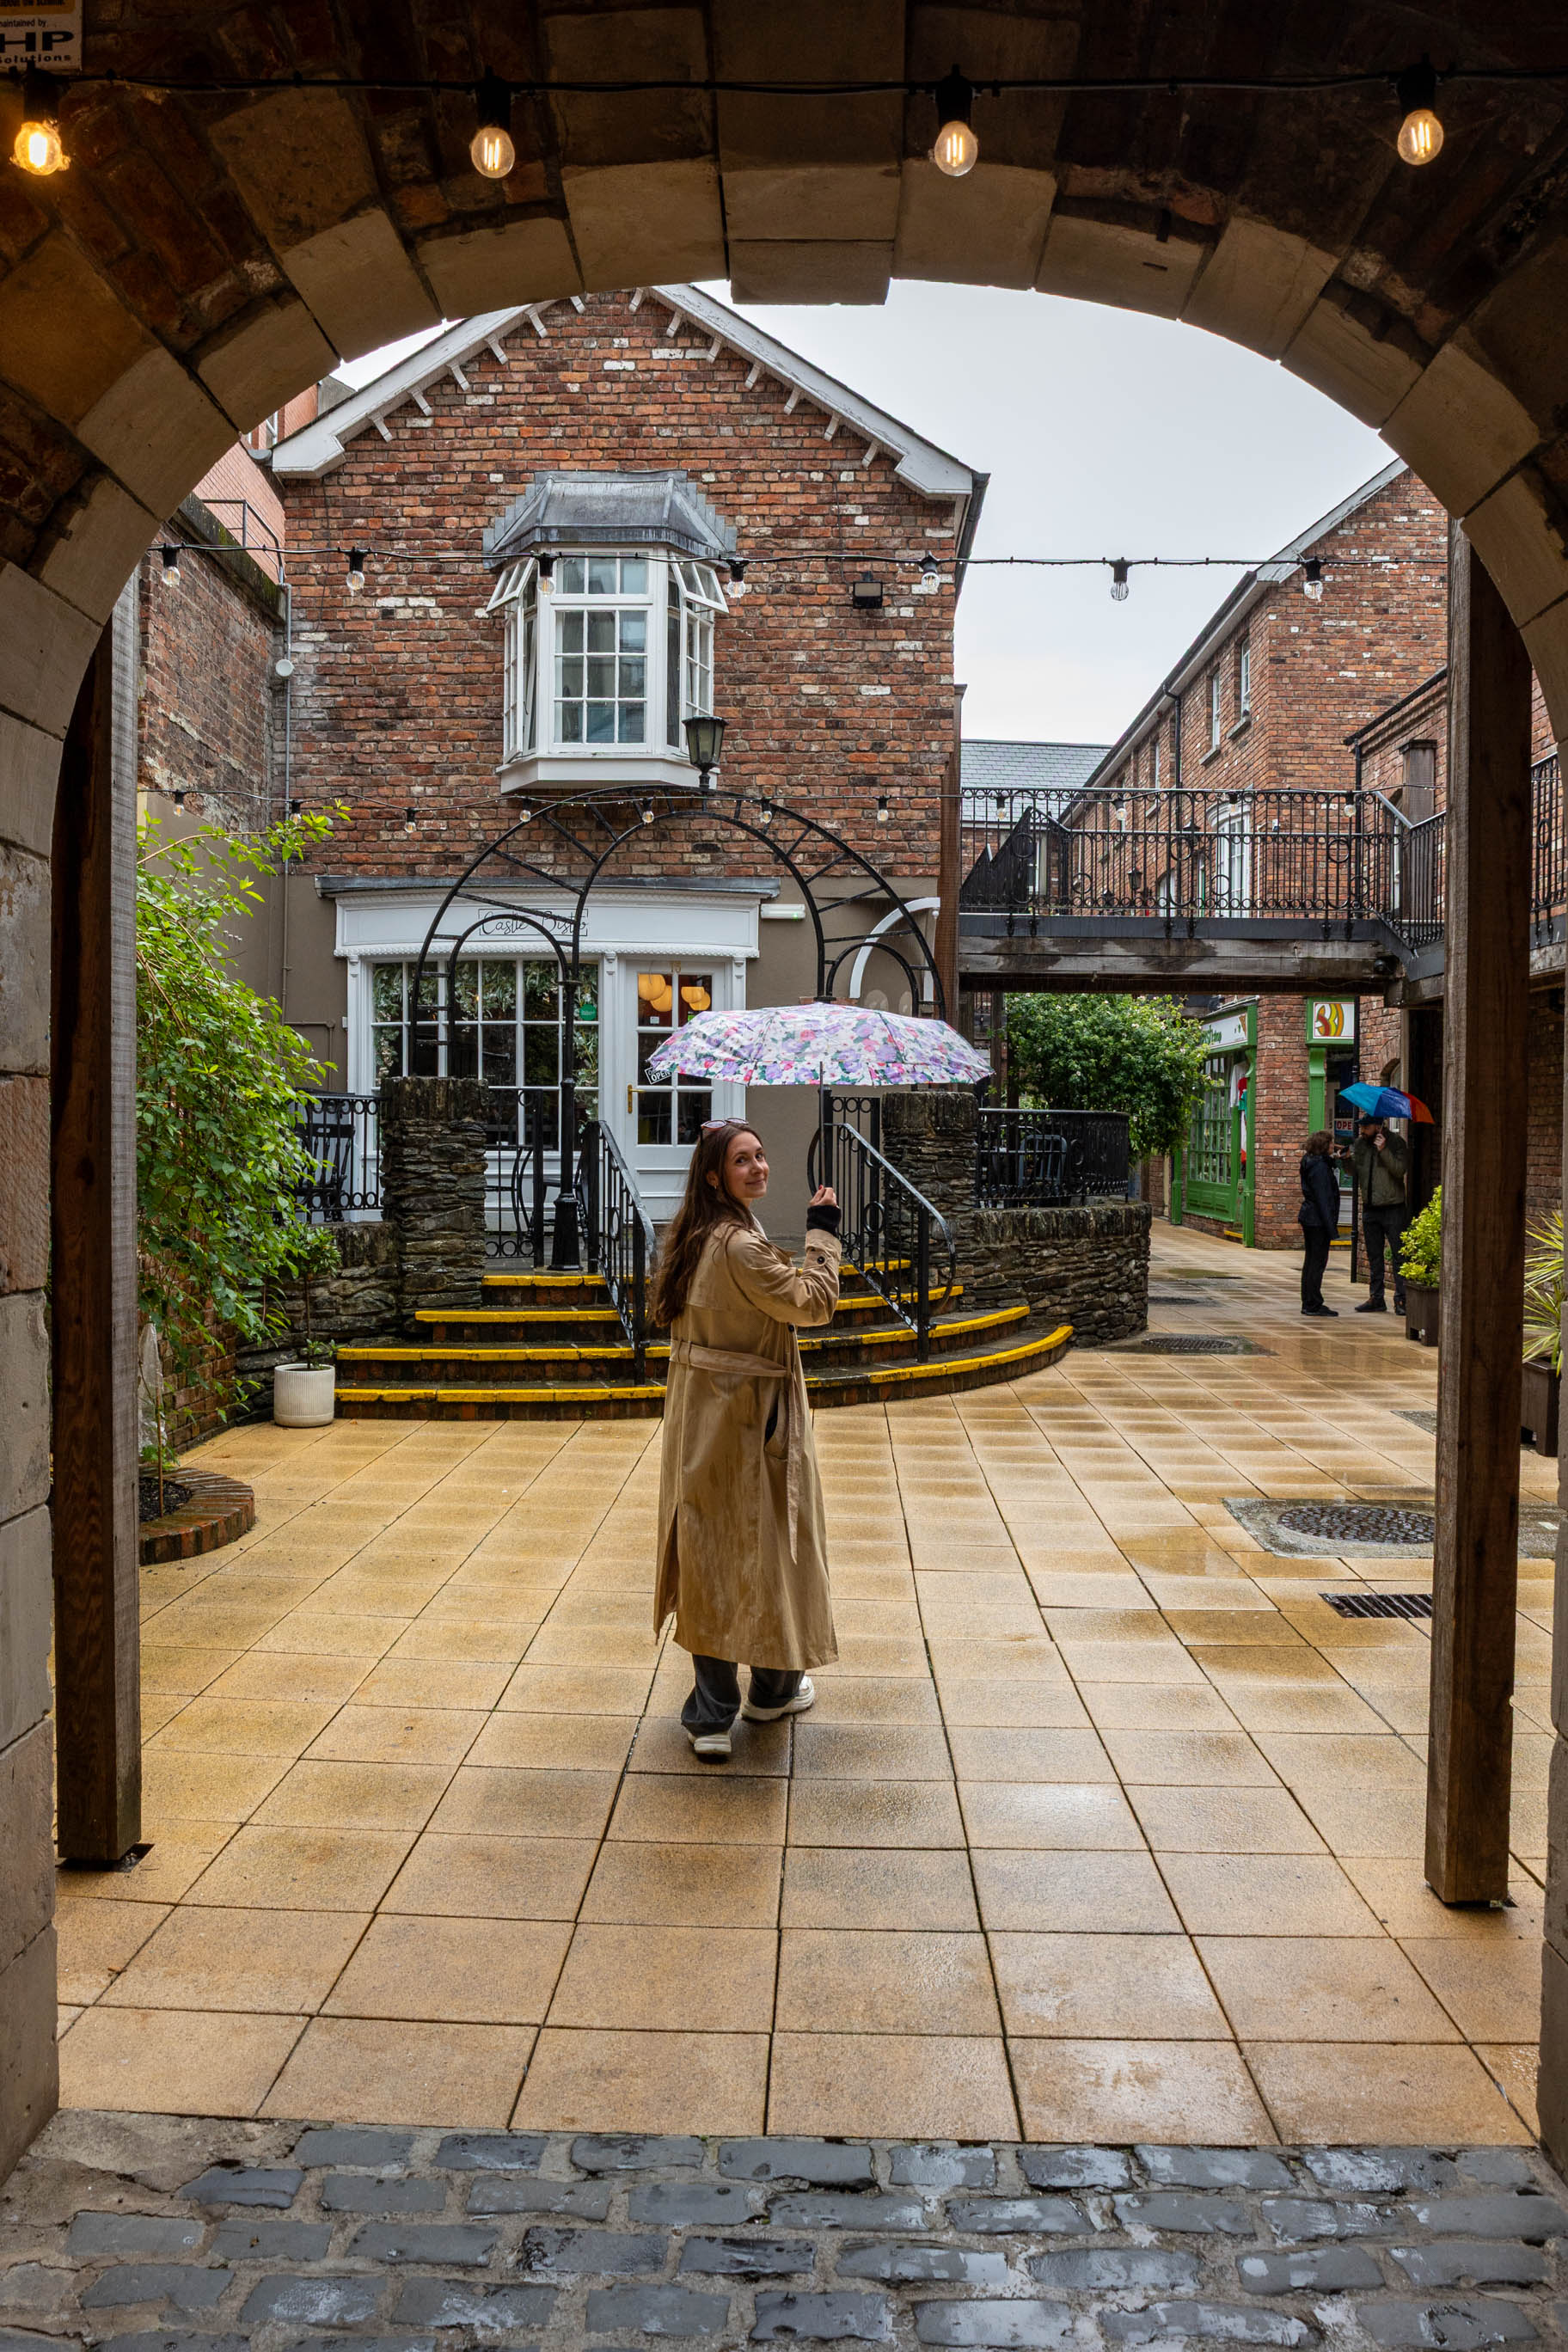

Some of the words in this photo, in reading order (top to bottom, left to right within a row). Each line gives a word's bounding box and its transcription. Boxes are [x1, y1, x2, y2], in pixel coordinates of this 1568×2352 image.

[38, 18, 47, 28] by
[481, 911, 532, 934] Castle
[538, 911, 588, 934] Bisto
[651, 1071, 671, 1081] OPEN
[1337, 1120, 1353, 1130] OPE
